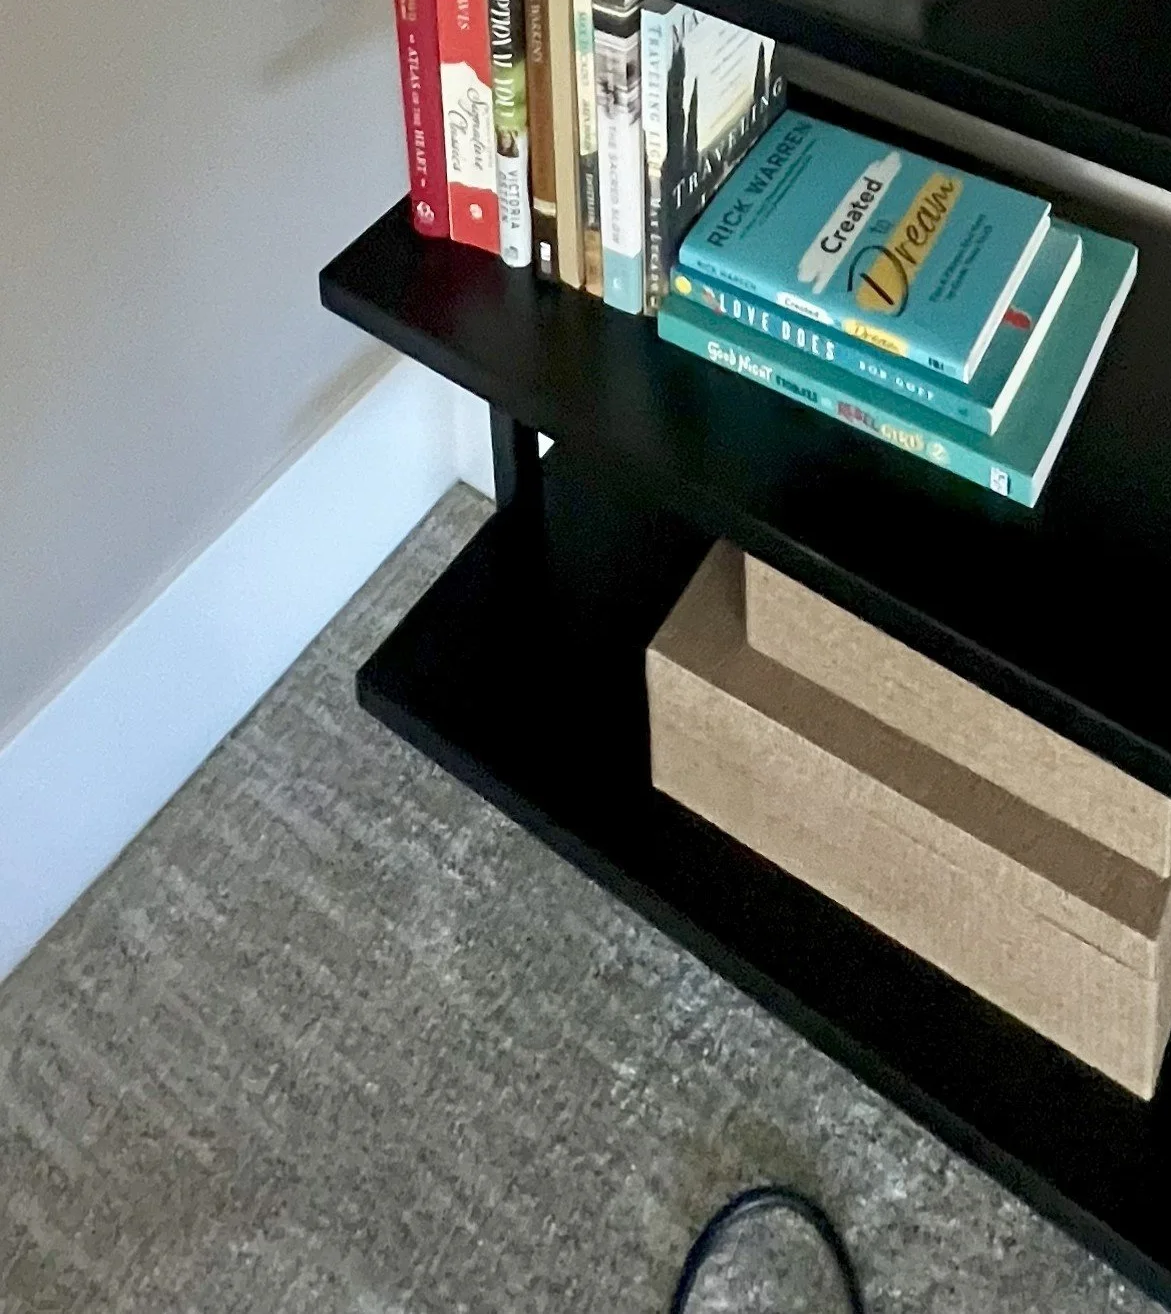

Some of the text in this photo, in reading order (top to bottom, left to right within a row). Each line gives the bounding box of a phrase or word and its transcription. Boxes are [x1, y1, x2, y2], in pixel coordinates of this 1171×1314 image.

[407, 46, 421, 90] ATLAS
[648, 23, 663, 123] TRAVELING
[413, 129, 428, 176] HEART
[672, 75, 784, 209] TRAVELING
[507, 169, 522, 230] VICTORIA
[706, 198, 752, 248] RICK
[747, 118, 814, 195] WARREN
[820, 176, 884, 255] Created
[847, 180, 956, 317] Dream
[718, 293, 836, 361] LOVE DOES
[859, 360, 935, 401] BOB GOFF
